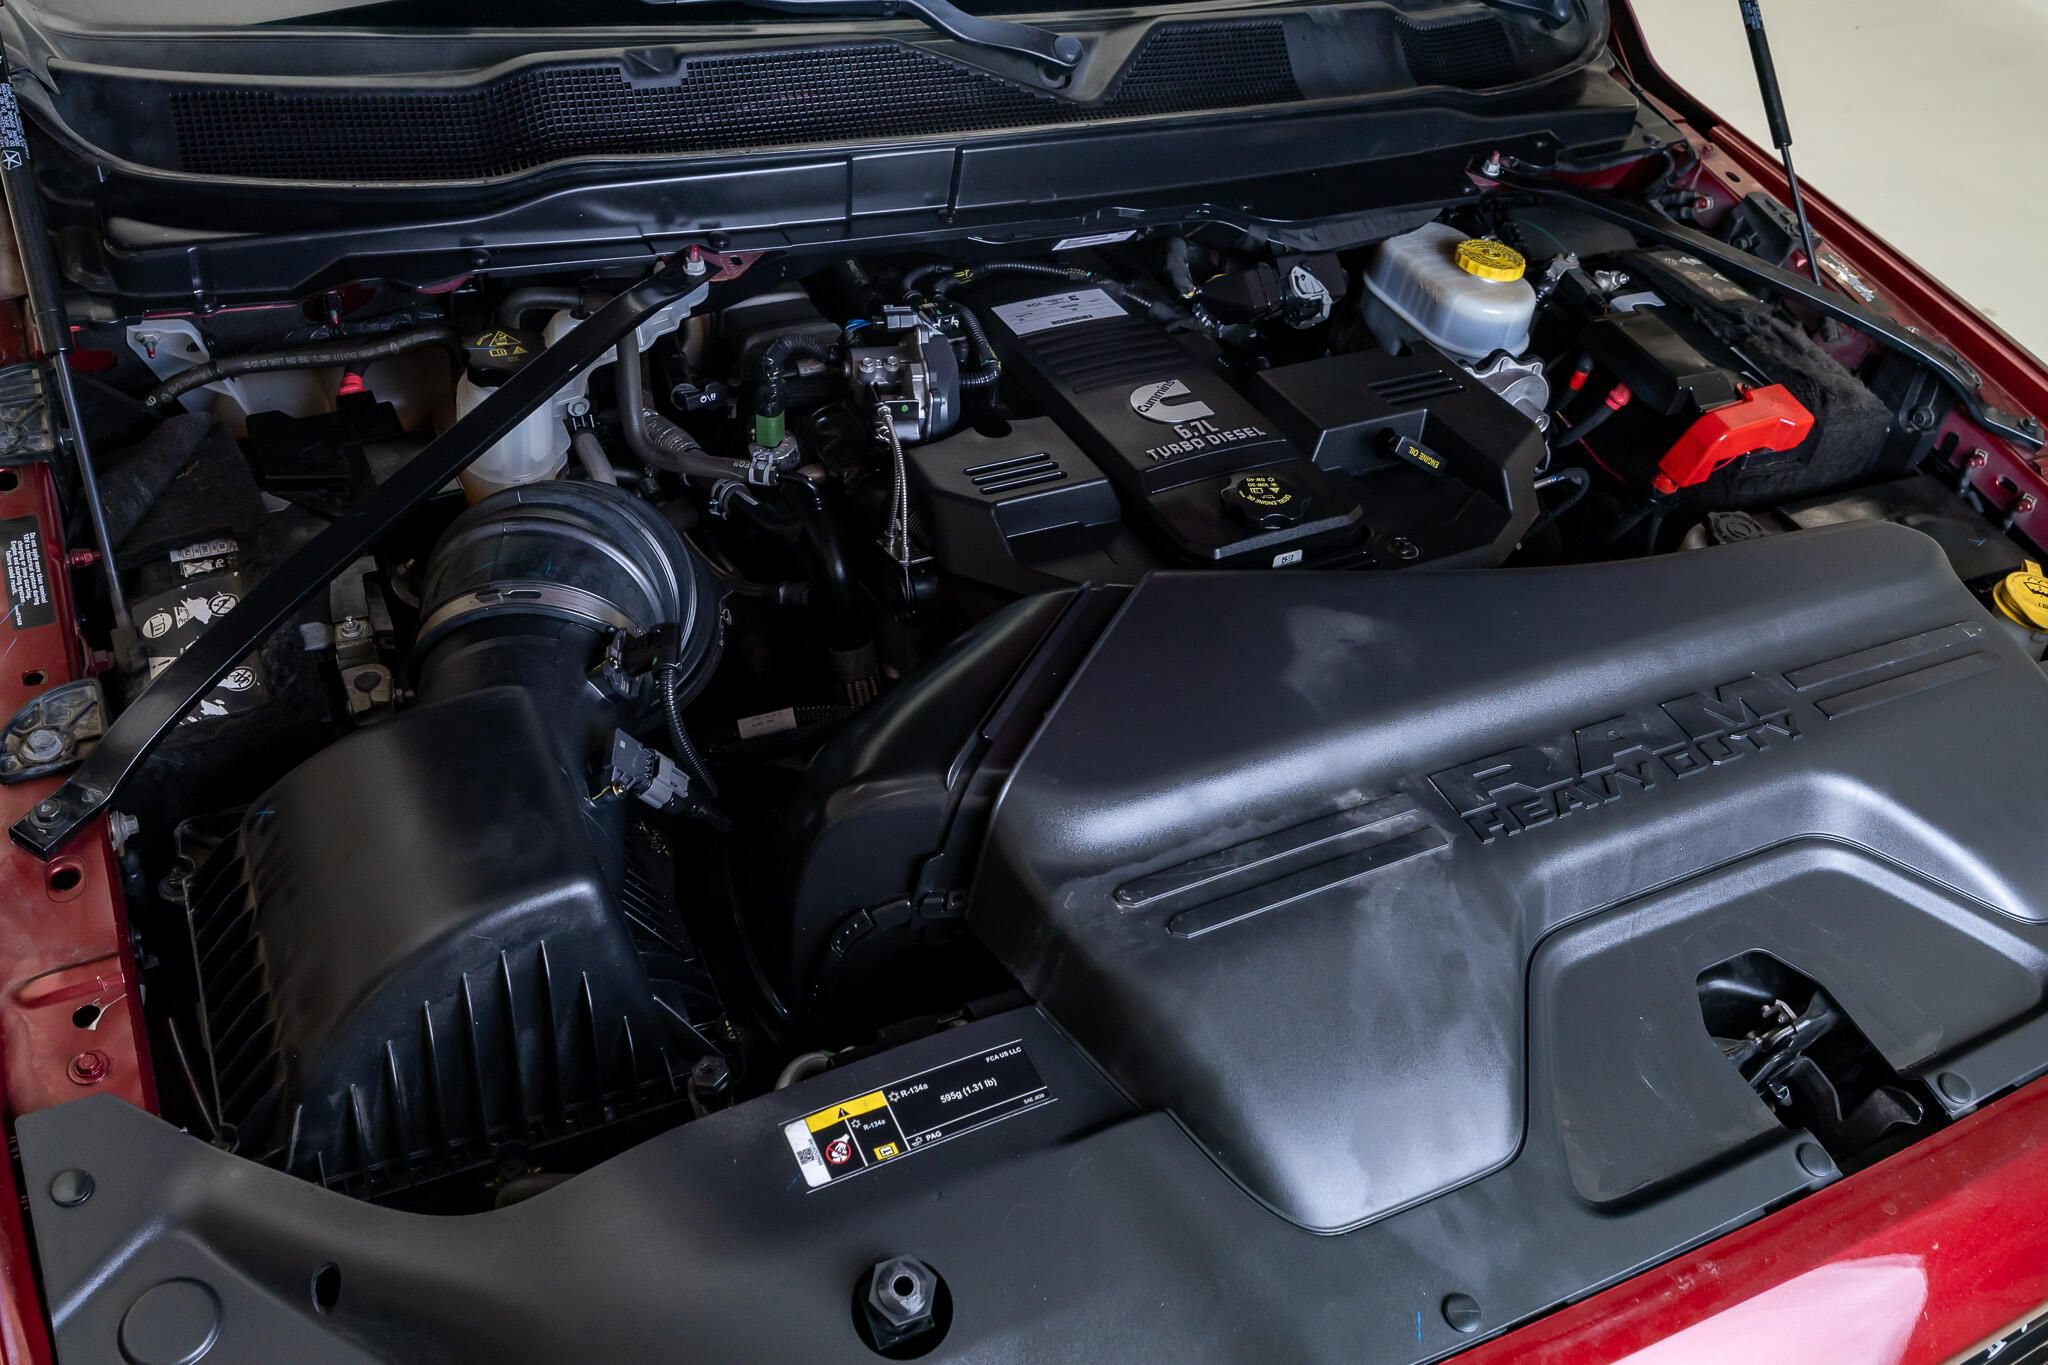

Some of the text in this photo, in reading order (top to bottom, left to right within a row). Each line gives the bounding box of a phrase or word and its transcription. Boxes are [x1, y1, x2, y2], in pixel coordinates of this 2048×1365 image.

[1137, 380, 1175, 412] Cummins
[1173, 420, 1220, 439] 6.7L
[1145, 426, 1267, 462] TURBO DIESEL
[1426, 673, 1791, 817] RAM
[1467, 712, 1802, 845] HEAVY DUTY
[985, 1046, 1022, 1064] FCA US LLC
[900, 1082, 929, 1098] R-134a
[940, 1077, 998, 1104] 595g (1.31 lb)
[863, 1118, 886, 1132] R-134a
[926, 1130, 942, 1142] PAG
